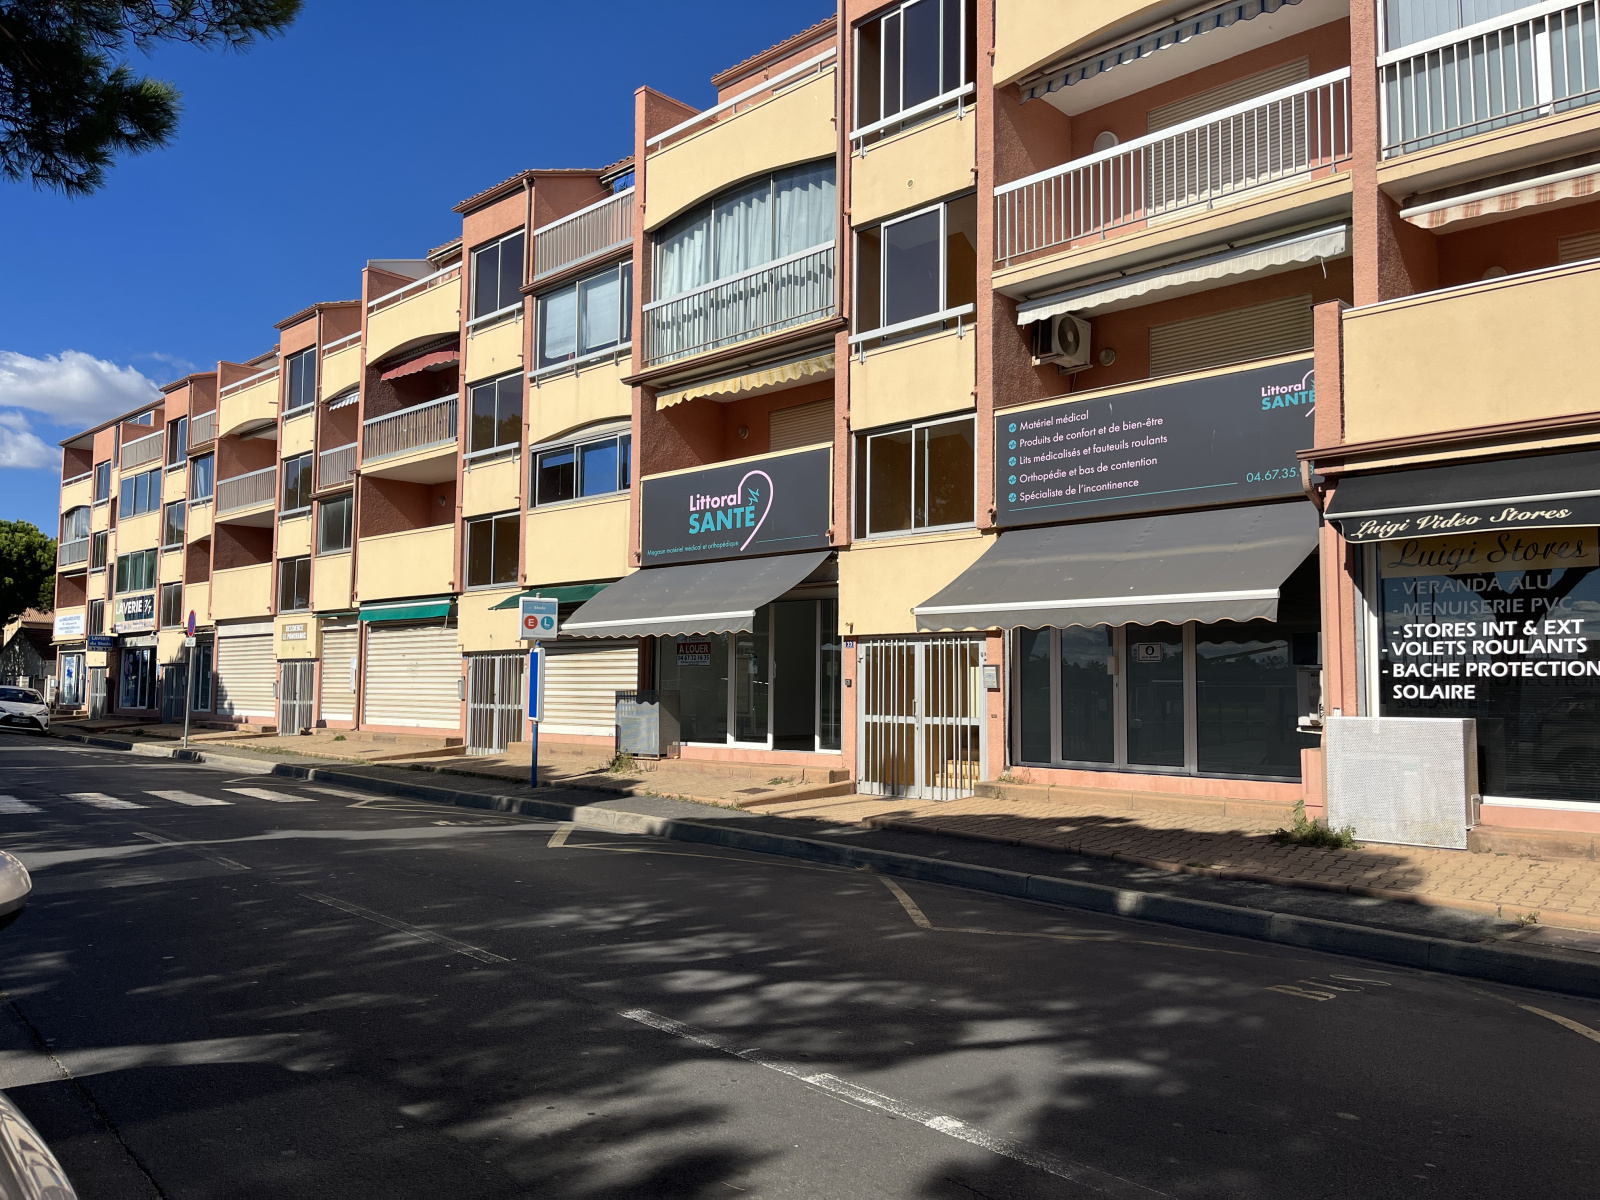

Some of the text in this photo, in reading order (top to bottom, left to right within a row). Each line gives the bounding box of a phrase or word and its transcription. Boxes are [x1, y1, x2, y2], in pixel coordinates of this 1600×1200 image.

[1262, 378, 1305, 397] Littoral
[1019, 410, 1089, 431] Matériel médical
[1019, 418, 1164, 448] Produits de confort et de bien-être
[1019, 435, 1168, 464] Lits médicalisés et fauteuils roulants
[1019, 457, 1158, 483] Orthopédie et bas de contention
[690, 487, 741, 512] Littoral
[1019, 479, 1139, 502] Spécialiste de l'incontinence
[1350, 507, 1572, 539] Luigi Vidéo Stores
[666, 546, 684, 554] matériel
[684, 544, 702, 552] médical
[708, 540, 738, 550] orthopédique
[1388, 534, 1588, 572] Luigi Stores
[1402, 577, 1504, 595] VERANDA
[1509, 574, 1552, 590] ALU
[116, 600, 142, 615] LAVERIE
[1403, 598, 1524, 617] MENUISERIE
[1531, 596, 1573, 612] PVC
[528, 618, 550, 626] E L
[1403, 622, 1476, 638] STORES
[1482, 620, 1518, 637] INT
[1522, 620, 1538, 636] &
[1544, 618, 1584, 635] EXT
[678, 644, 708, 654] A LOUER
[1392, 640, 1466, 656] VOLETS
[1472, 637, 1588, 655] ROULANTS
[1392, 662, 1460, 678] BACHE
[1466, 660, 1600, 678] PROTECTION
[1392, 684, 1476, 700] SOLAIRE
